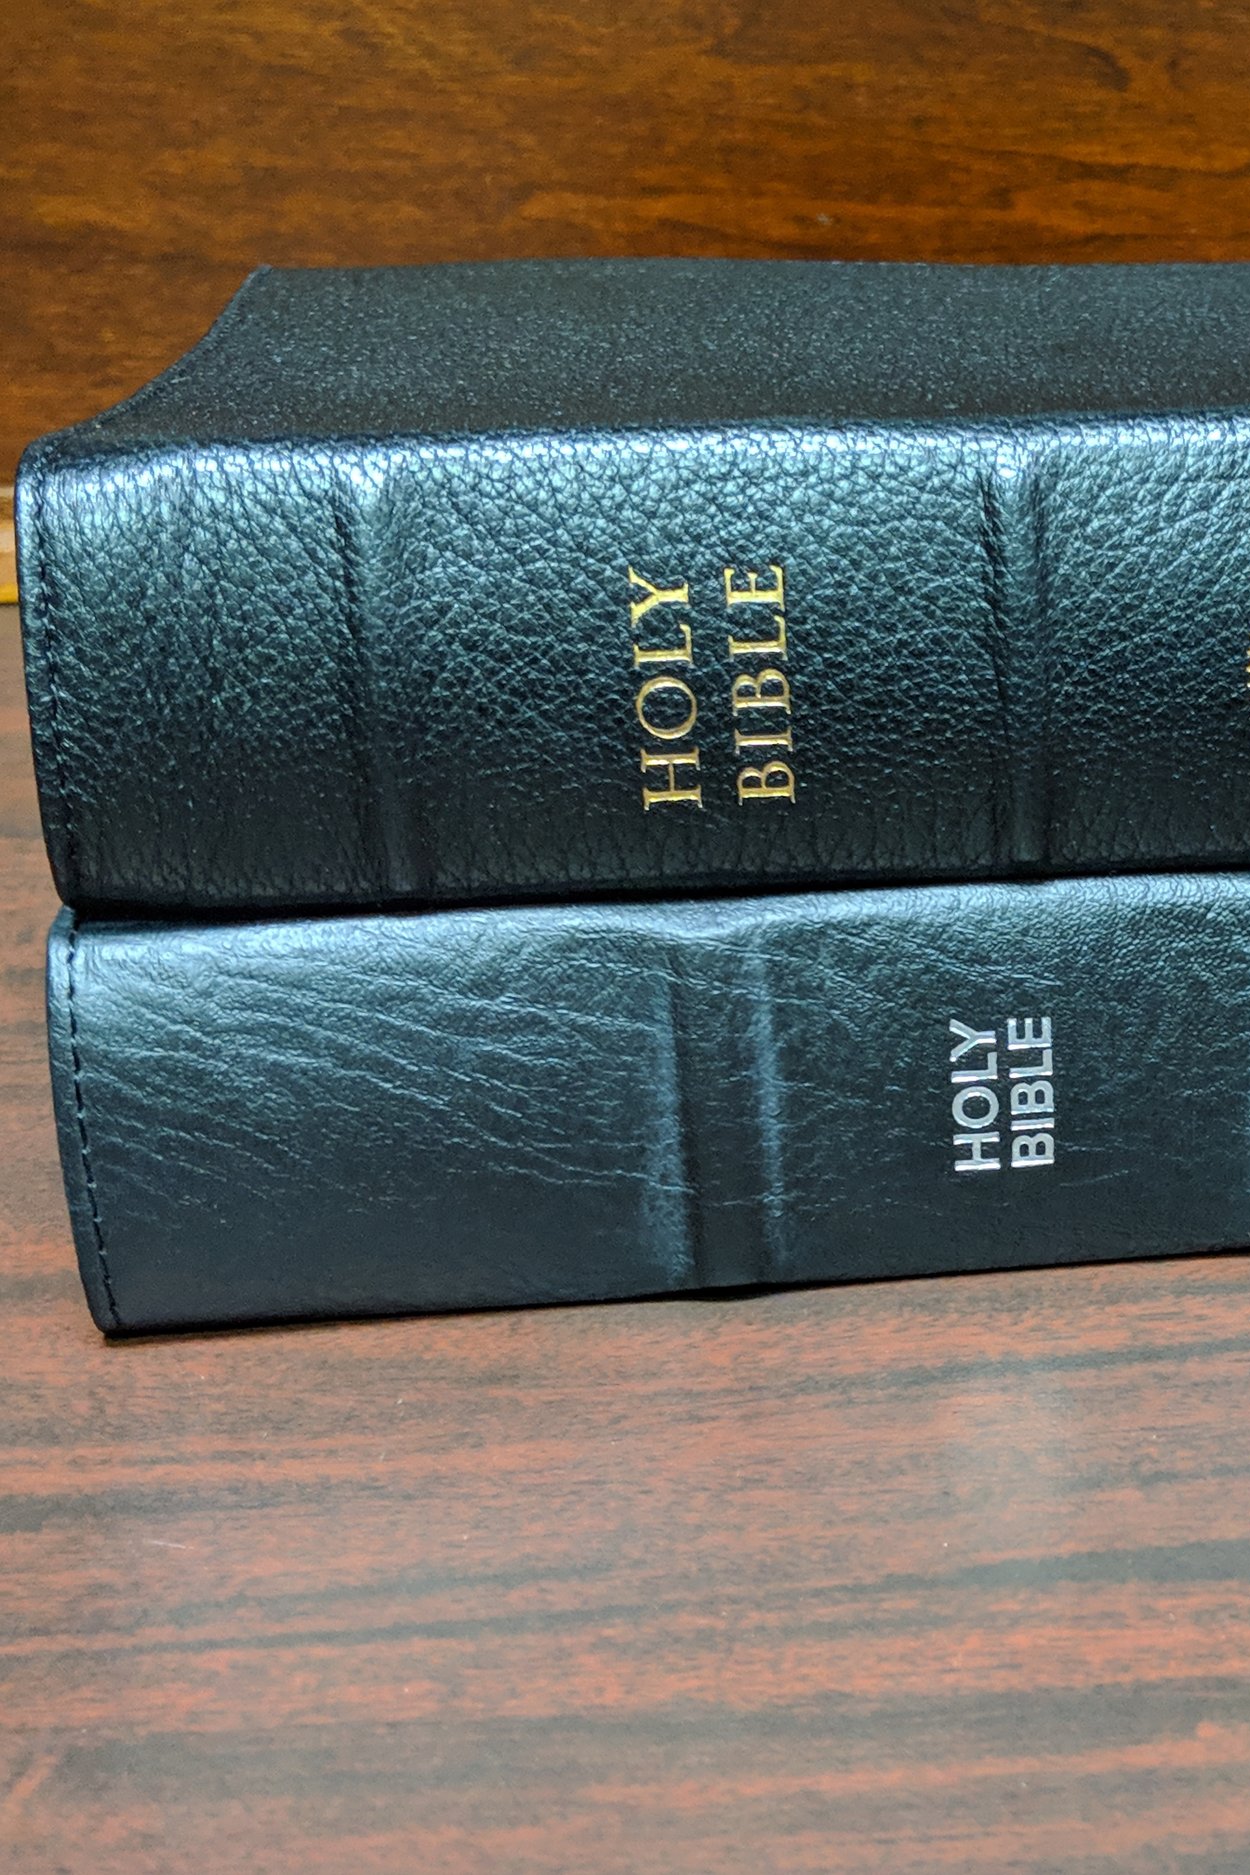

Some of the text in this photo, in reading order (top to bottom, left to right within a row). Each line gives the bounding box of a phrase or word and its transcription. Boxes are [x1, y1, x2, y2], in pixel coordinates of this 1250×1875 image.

[628, 565, 703, 811] HOLY
[724, 565, 796, 806] BIBLE
[949, 1018, 1001, 1172] HOLY
[1007, 1016, 1055, 1168] BIBLE
